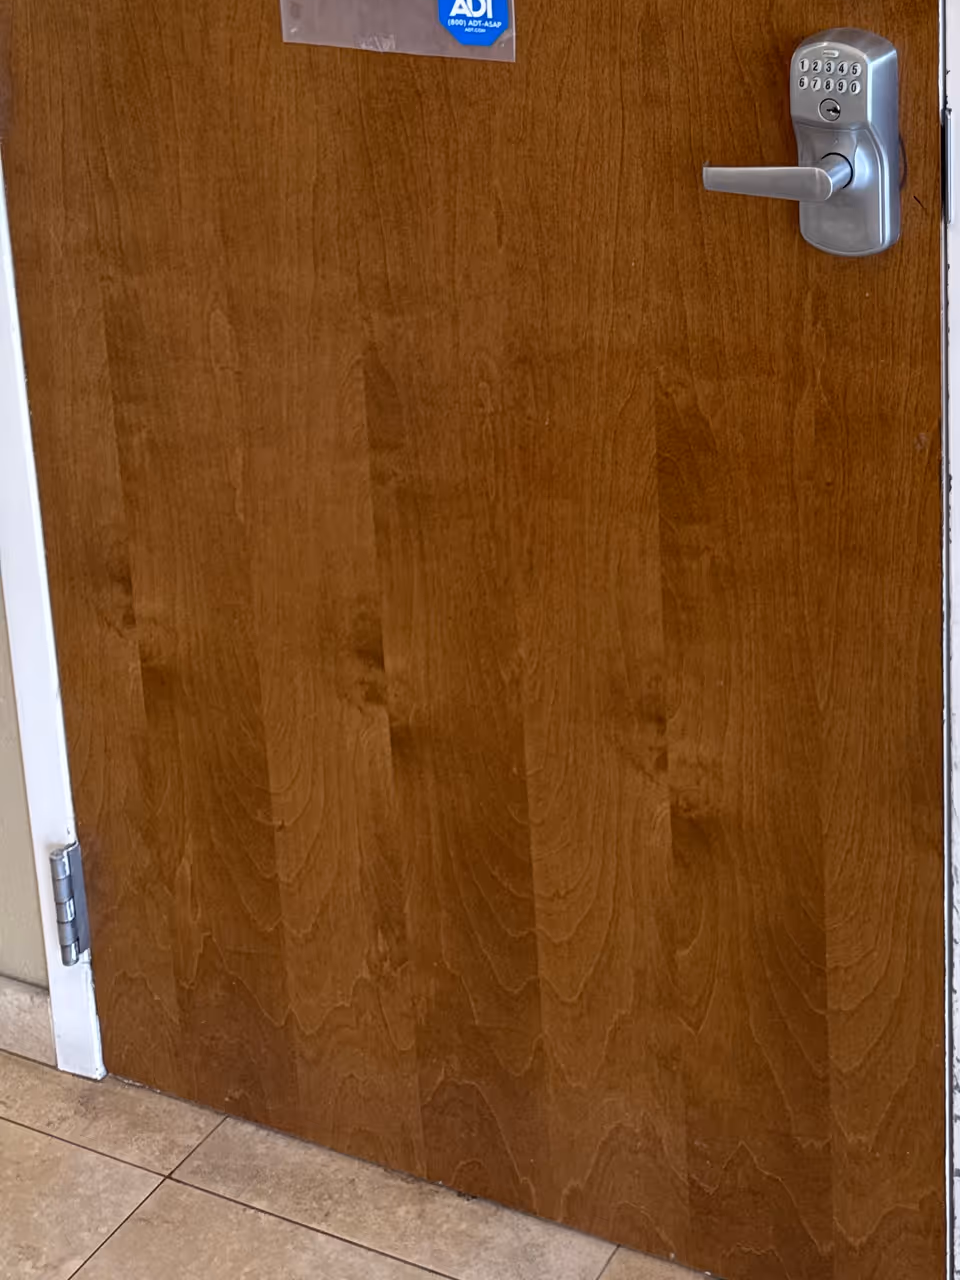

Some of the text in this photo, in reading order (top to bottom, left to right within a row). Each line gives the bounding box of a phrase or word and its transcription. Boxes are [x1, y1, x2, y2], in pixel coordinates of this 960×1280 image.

[448, 19, 502, 28] (800) ADT-ASAP
[801, 60, 857, 75] 1 2 3 4 5
[799, 78, 856, 92] 6 7 8 9 0
